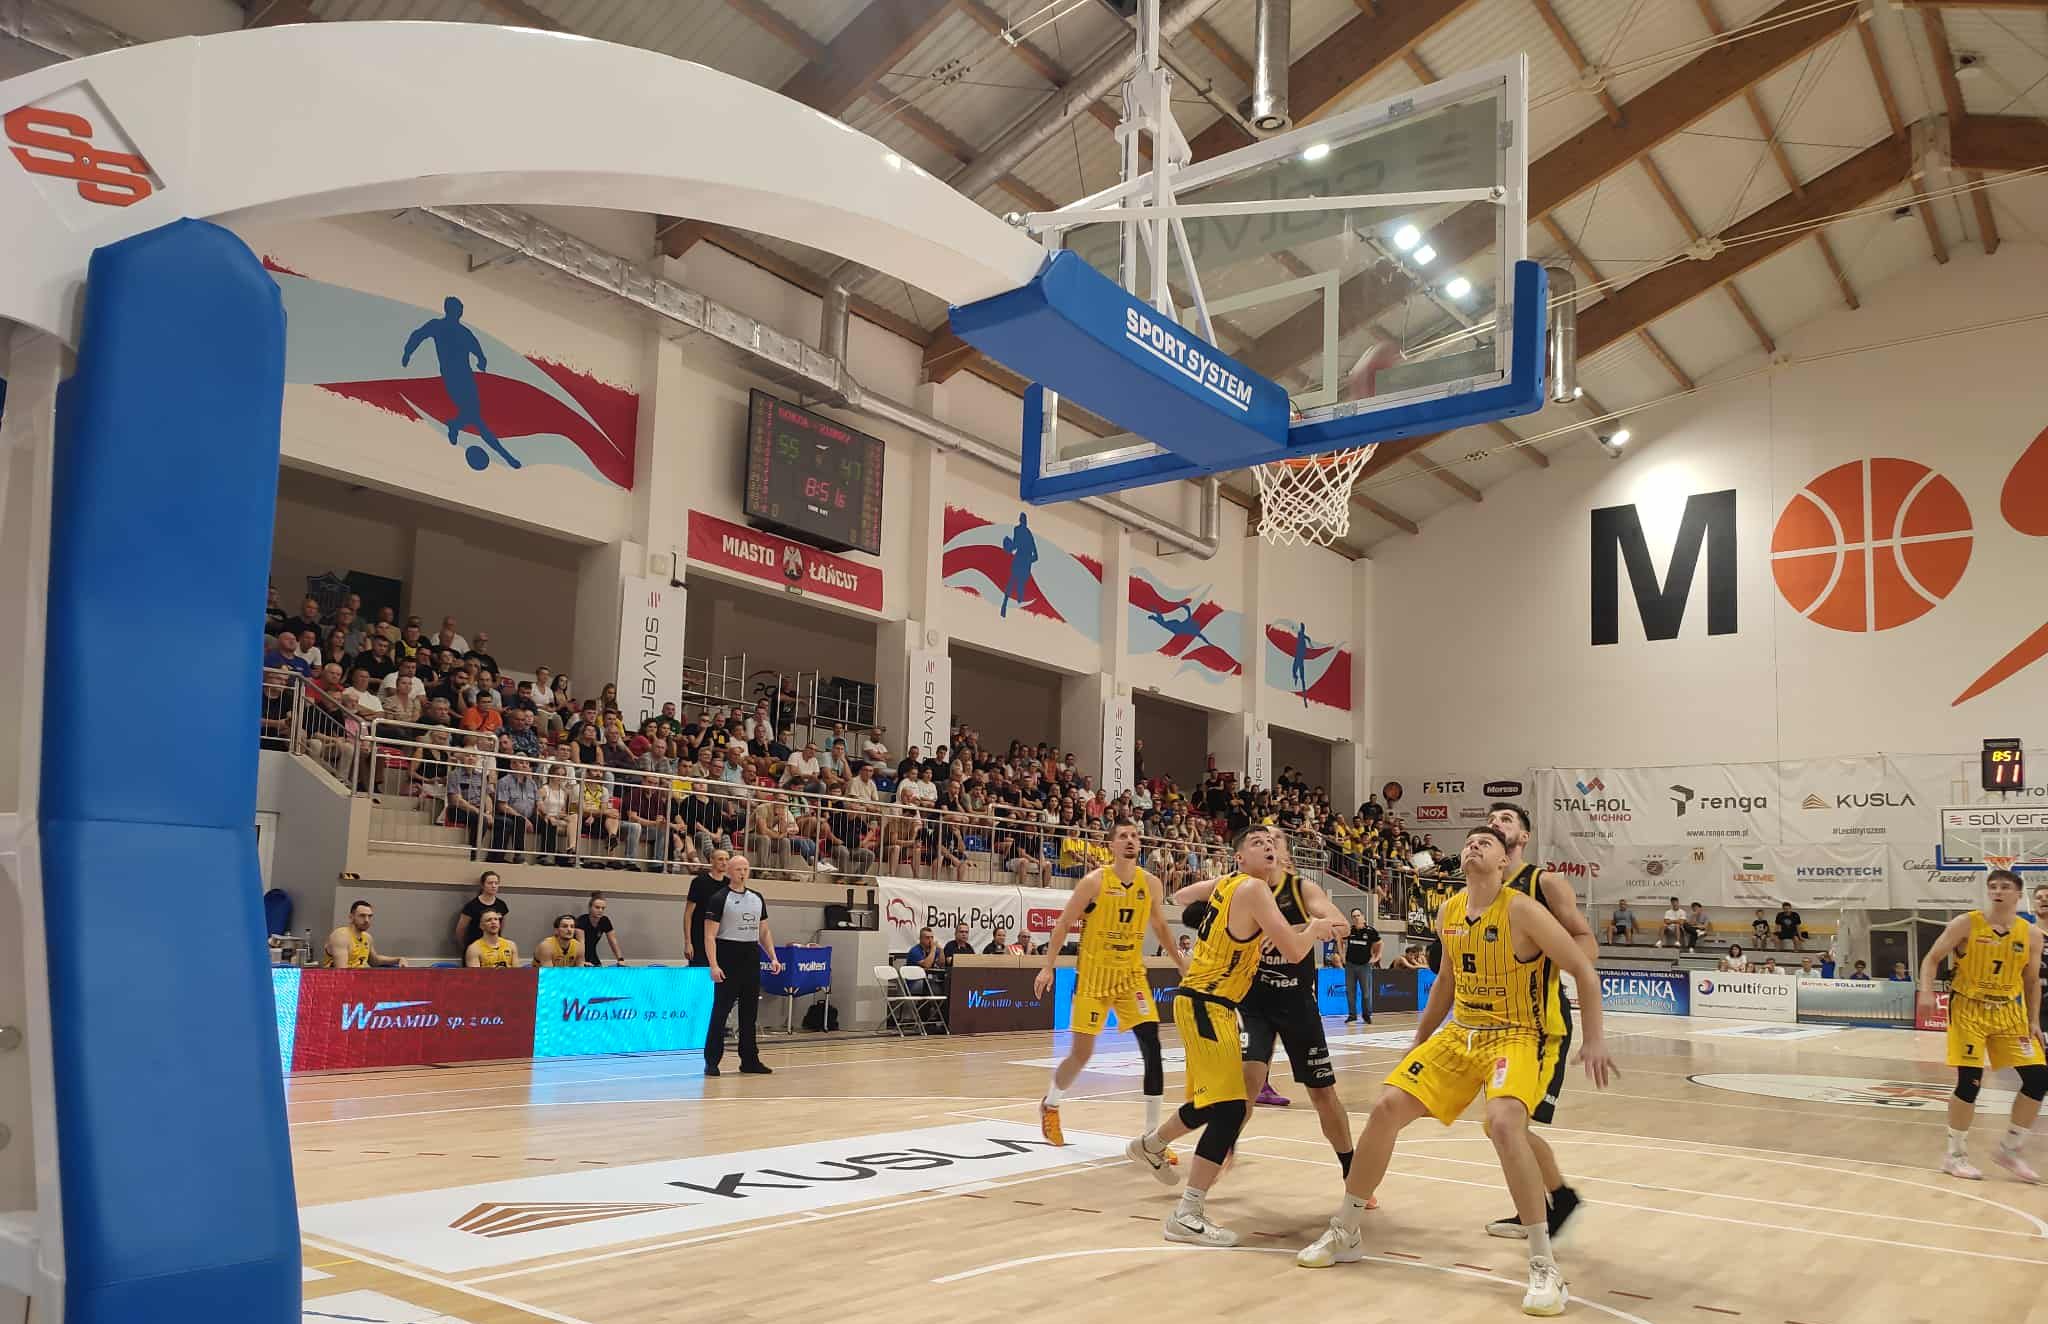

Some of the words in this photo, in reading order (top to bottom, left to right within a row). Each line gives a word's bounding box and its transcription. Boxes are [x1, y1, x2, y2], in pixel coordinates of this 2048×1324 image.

[1126, 307, 1187, 364] SPORT
[1187, 348, 1254, 405] SYSTEM
[722, 534, 775, 567] MIASTO
[809, 562, 858, 592] ŁAŃCUT
[923, 681, 937, 761] solver
[1995, 764, 2020, 783] 11
[1553, 799, 1632, 812] STAL-ROL
[1700, 796, 1768, 813] renga
[1836, 793, 1916, 808] KUSLA
[1418, 806, 1447, 818] INOX
[1589, 813, 1632, 822] MICHNO
[1796, 866, 1882, 877] HYDROTECH
[927, 905, 967, 928] Bank
[970, 907, 1015, 930] Pekao
[1118, 908, 1135, 923] 17
[1462, 953, 1476, 973] 6
[1992, 960, 2003, 975] 7
[1602, 978, 1677, 1002] SELENKA
[1717, 983, 1789, 997] multifarb
[341, 1000, 440, 1031] WIDAMID
[446, 1016, 466, 1030] sp.
[480, 1015, 504, 1025] o.o.
[562, 997, 637, 1021] WIDAMID
[664, 1137, 1068, 1200] KUSLA
